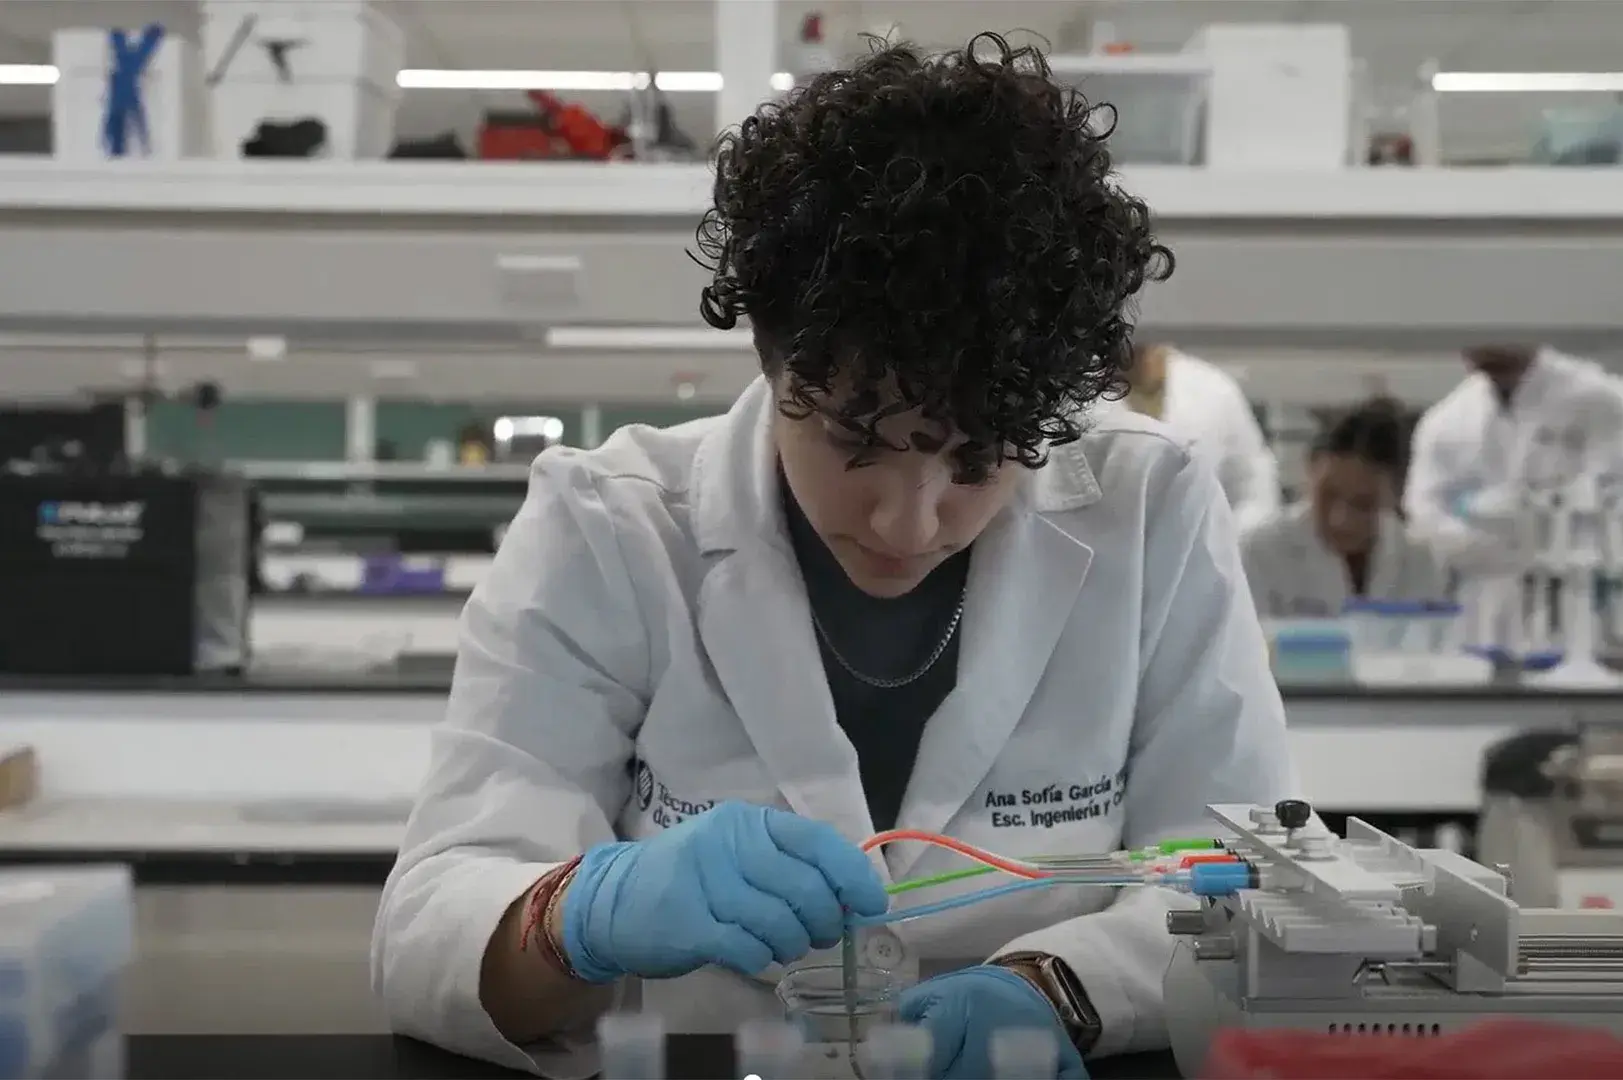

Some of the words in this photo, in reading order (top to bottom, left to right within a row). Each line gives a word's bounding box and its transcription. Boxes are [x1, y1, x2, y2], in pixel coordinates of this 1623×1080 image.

[985, 791, 1016, 807] Ana
[1021, 784, 1063, 805] Sofía
[1069, 775, 1111, 800] García
[653, 806, 670, 829] de
[992, 812, 1026, 828] Esc.
[1030, 800, 1100, 828] Ingeniería
